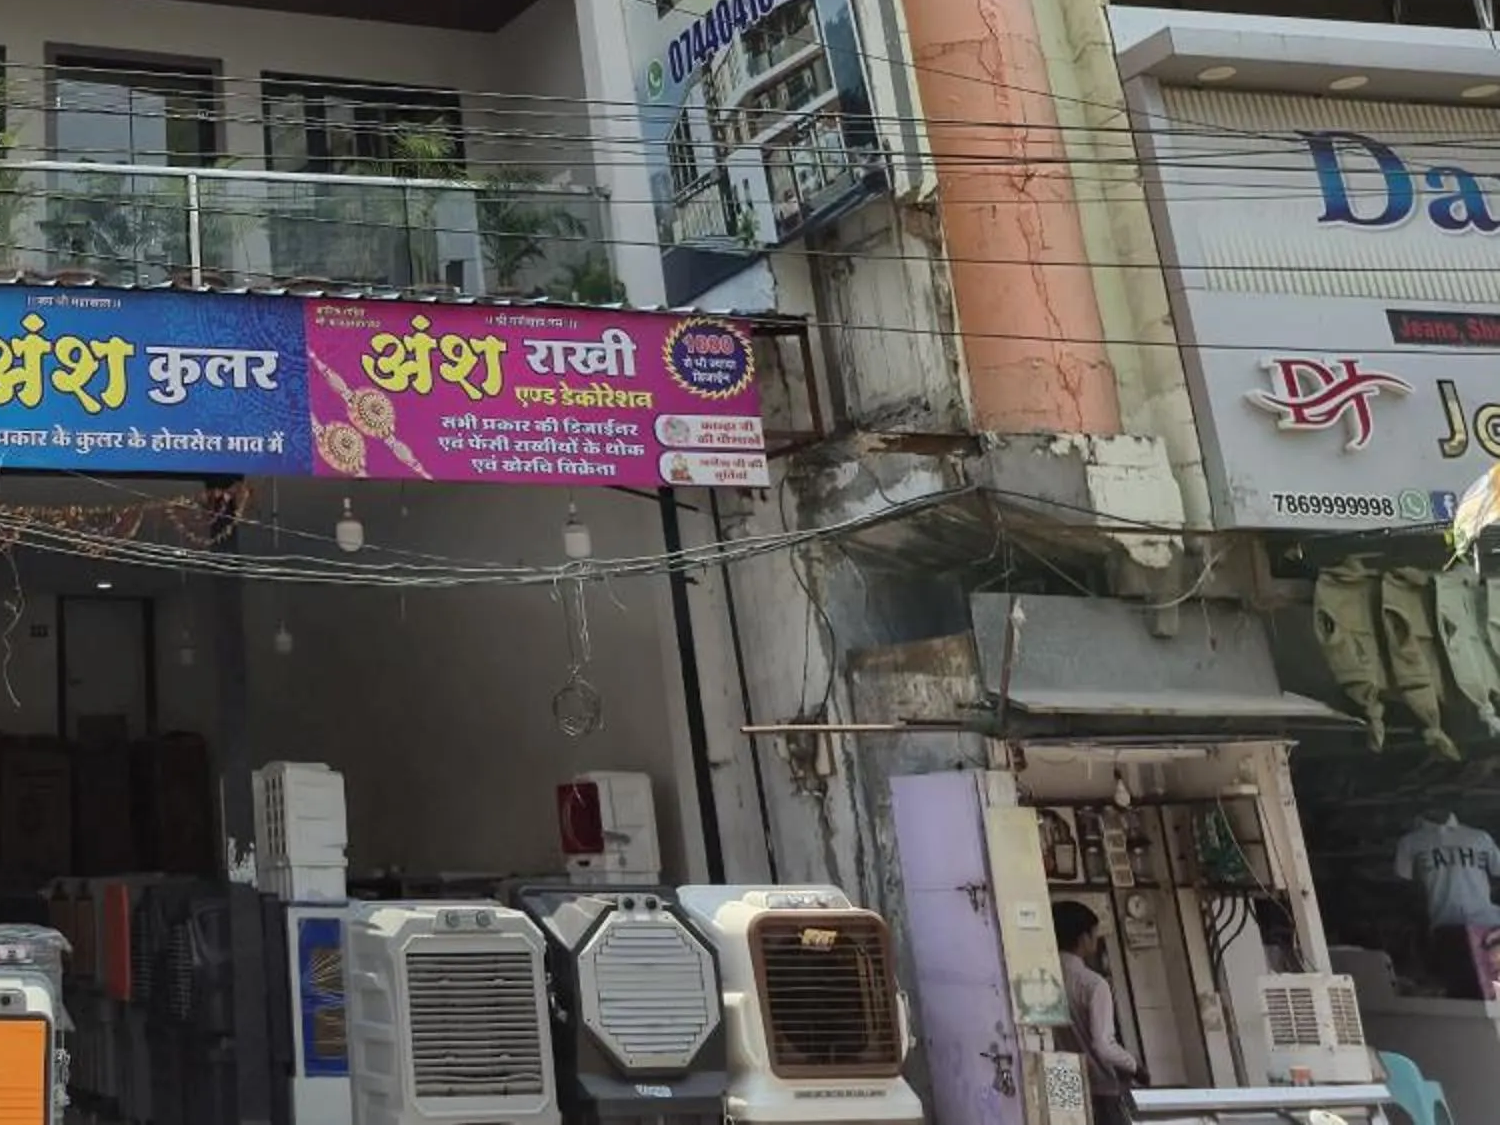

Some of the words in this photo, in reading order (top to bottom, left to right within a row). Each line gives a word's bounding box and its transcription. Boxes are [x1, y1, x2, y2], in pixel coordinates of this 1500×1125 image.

[361, 314, 507, 400] अंश
[523, 327, 637, 376] राखी
[145, 346, 279, 404] कुलर
[514, 386, 556, 407] एण्ड
[560, 381, 654, 409] डेकोरेशन
[441, 413, 477, 430] सभी
[482, 417, 531, 432] प्रकार
[535, 416, 559, 433] की
[52, 425, 71, 446] के
[76, 432, 124, 453] कुलर
[127, 427, 146, 448] के
[151, 427, 222, 452] होलसेल
[227, 436, 264, 453] भाव
[268, 431, 285, 454] में
[438, 434, 464, 452] एवं
[582, 440, 601, 454] के
[605, 438, 645, 456] थोक
[471, 456, 498, 474] एवं
[557, 458, 617, 476] विक्रेता
[1273, 494, 1395, 518] 7869999998
